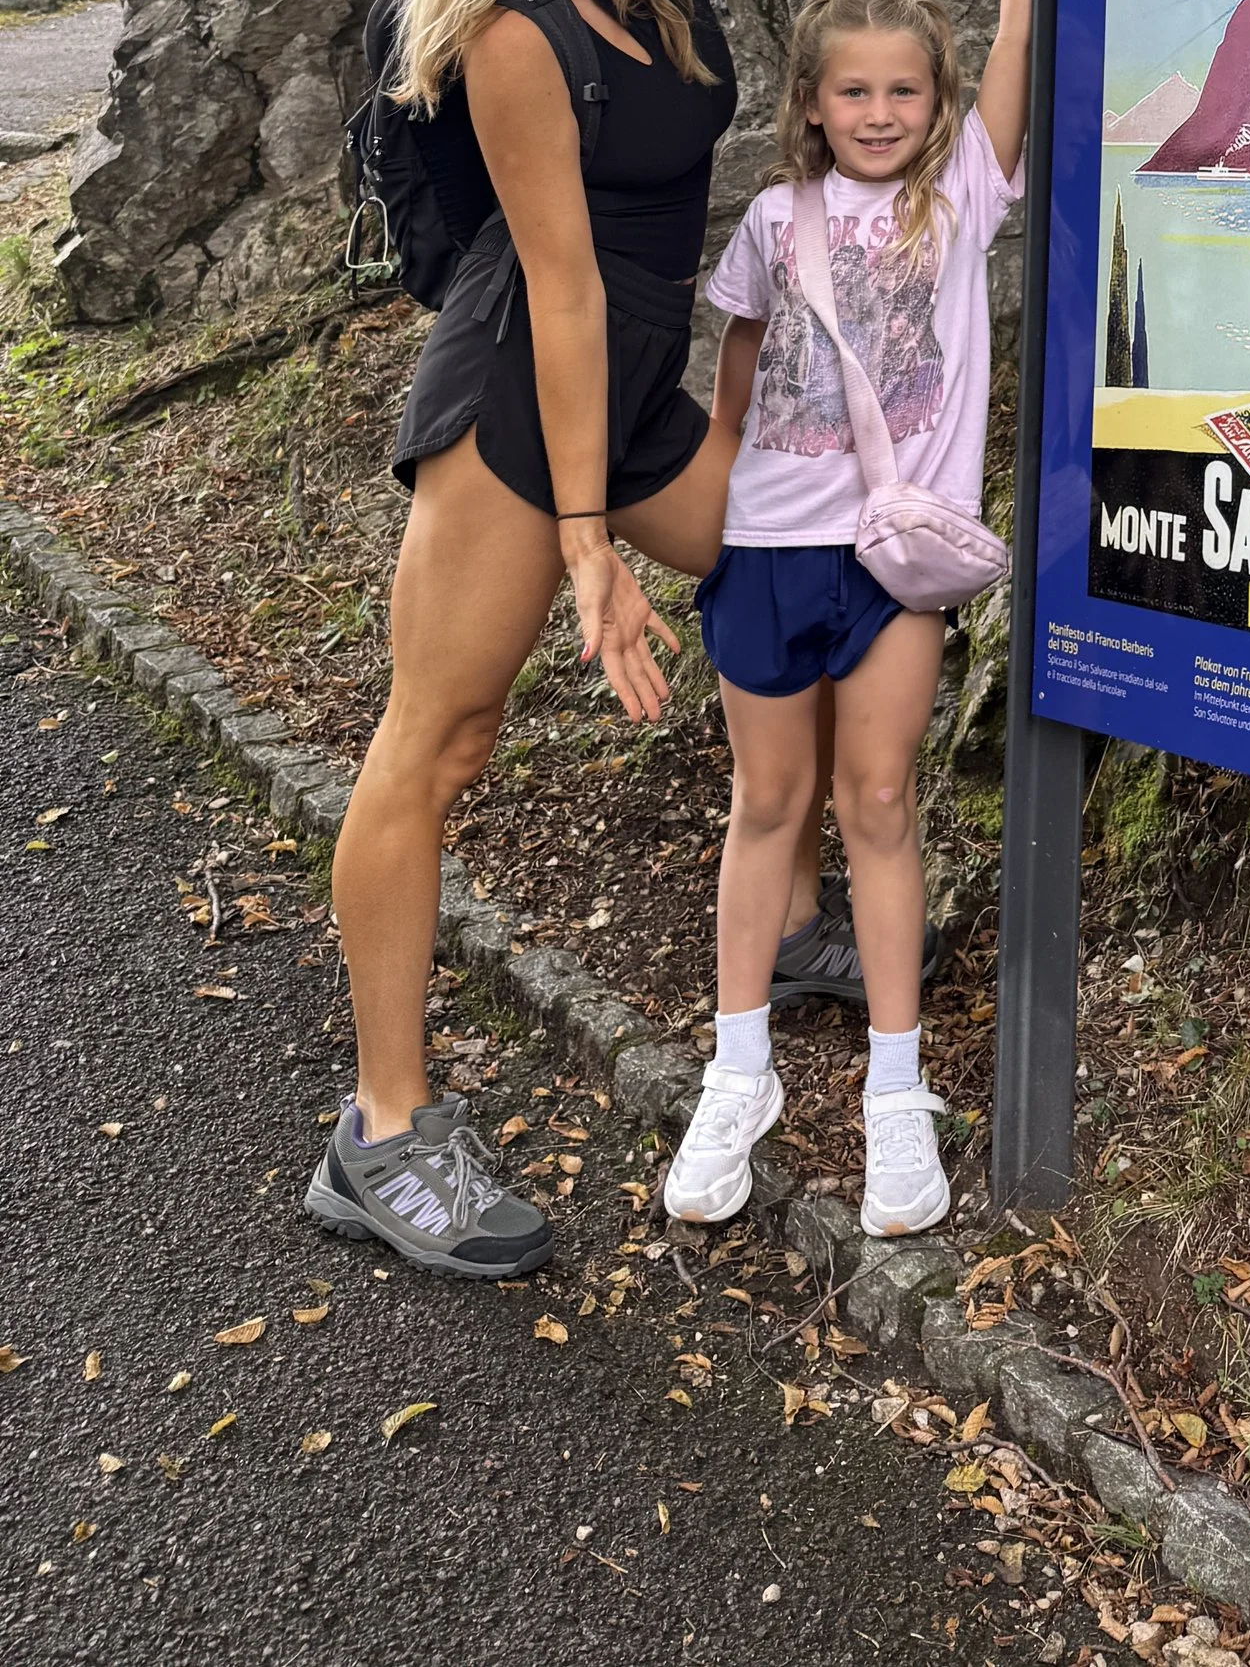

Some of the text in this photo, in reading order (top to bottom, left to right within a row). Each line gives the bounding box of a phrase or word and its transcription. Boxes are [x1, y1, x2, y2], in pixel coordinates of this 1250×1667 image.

[1099, 500, 1187, 563] MONTE
[1048, 621, 1155, 658] Manifesto di Franco Barberis
[1048, 637, 1079, 655] del 1939
[1047, 653, 1072, 669] Spiccano
[1078, 660, 1090, 673] San
[1090, 663, 1118, 680] Salvatore
[1118, 670, 1144, 687] irradiato
[1144, 677, 1155, 689] dal
[1155, 680, 1169, 693] sole
[1194, 655, 1222, 674] Plakat
[1223, 665, 1239, 679] von
[1056, 671, 1081, 687] tracciato
[1082, 677, 1096, 691] della
[1097, 680, 1127, 698] funicolare
[1194, 675, 1210, 688] aus
[1211, 676, 1230, 693] dem
[1194, 691, 1202, 701] Im
[1203, 693, 1240, 710] Mittelpunkt
[1193, 706, 1206, 719] San
[1206, 709, 1238, 728] Salvatore
[1238, 719, 1250, 732] und
